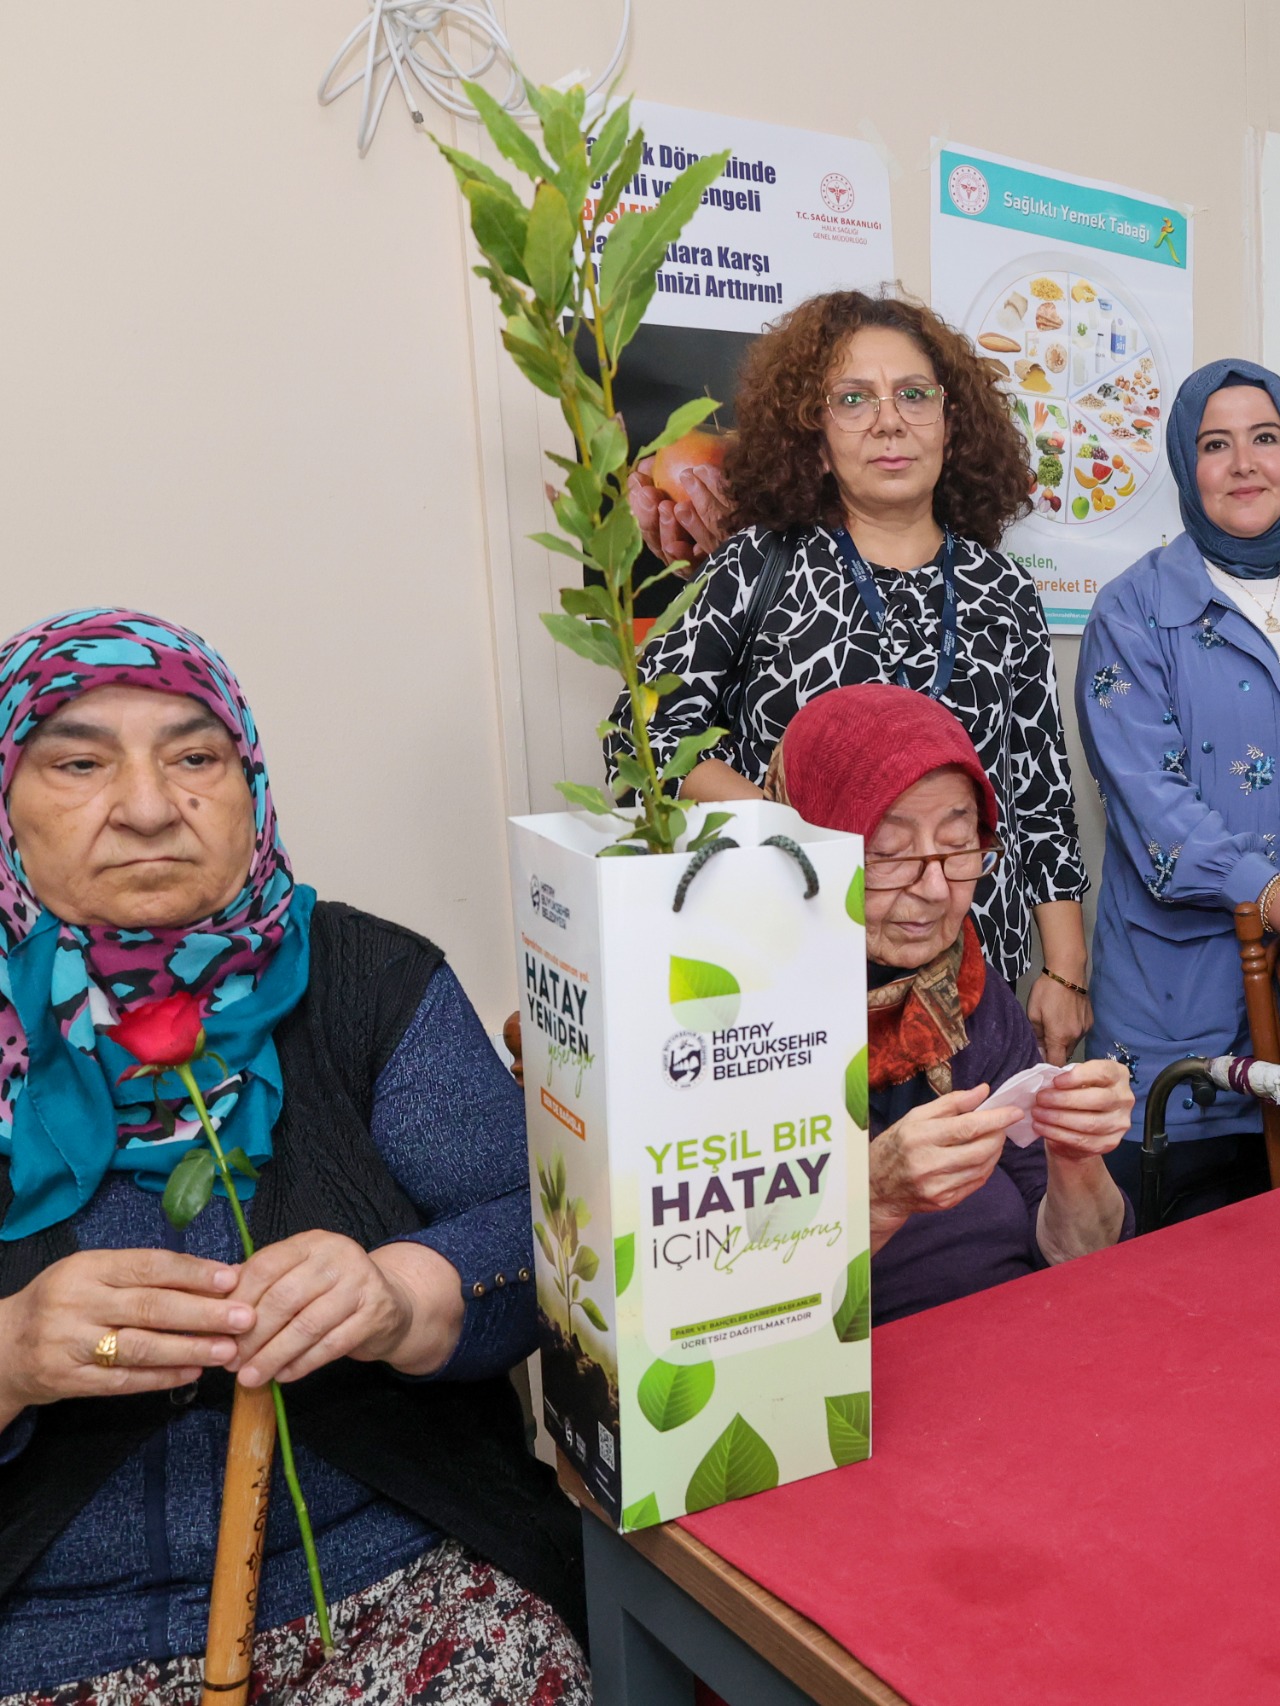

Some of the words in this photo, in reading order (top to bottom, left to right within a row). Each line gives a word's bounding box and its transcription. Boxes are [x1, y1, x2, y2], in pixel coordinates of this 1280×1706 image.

[700, 187, 762, 212] engeli
[796, 211, 809, 220] T.C.
[810, 213, 839, 224] SAĞLIK
[840, 217, 882, 230] BAKANLIĞI
[1003, 191, 1057, 218] Sağlıklı
[1060, 205, 1106, 231] Yemek
[1109, 216, 1150, 244] Tabağı
[717, 245, 770, 276] Karşı
[705, 274, 783, 304] Arttırın!
[1033, 577, 1080, 593] areket
[1084, 579, 1097, 593] Et
[525, 951, 587, 1026] HATAY
[527, 992, 589, 1062] YENİDEN
[712, 1021, 774, 1046] HATAY
[645, 1129, 762, 1174] YEŞİL
[773, 1114, 833, 1153] BİR
[652, 1152, 831, 1227] HATAY
[653, 1224, 730, 1271] İÇİN
[681, 1332, 727, 1350] ÜCRETSİZ
[729, 1311, 812, 1339] DAĞITILMAKTADIR
[696, 1324, 707, 1332] VE
